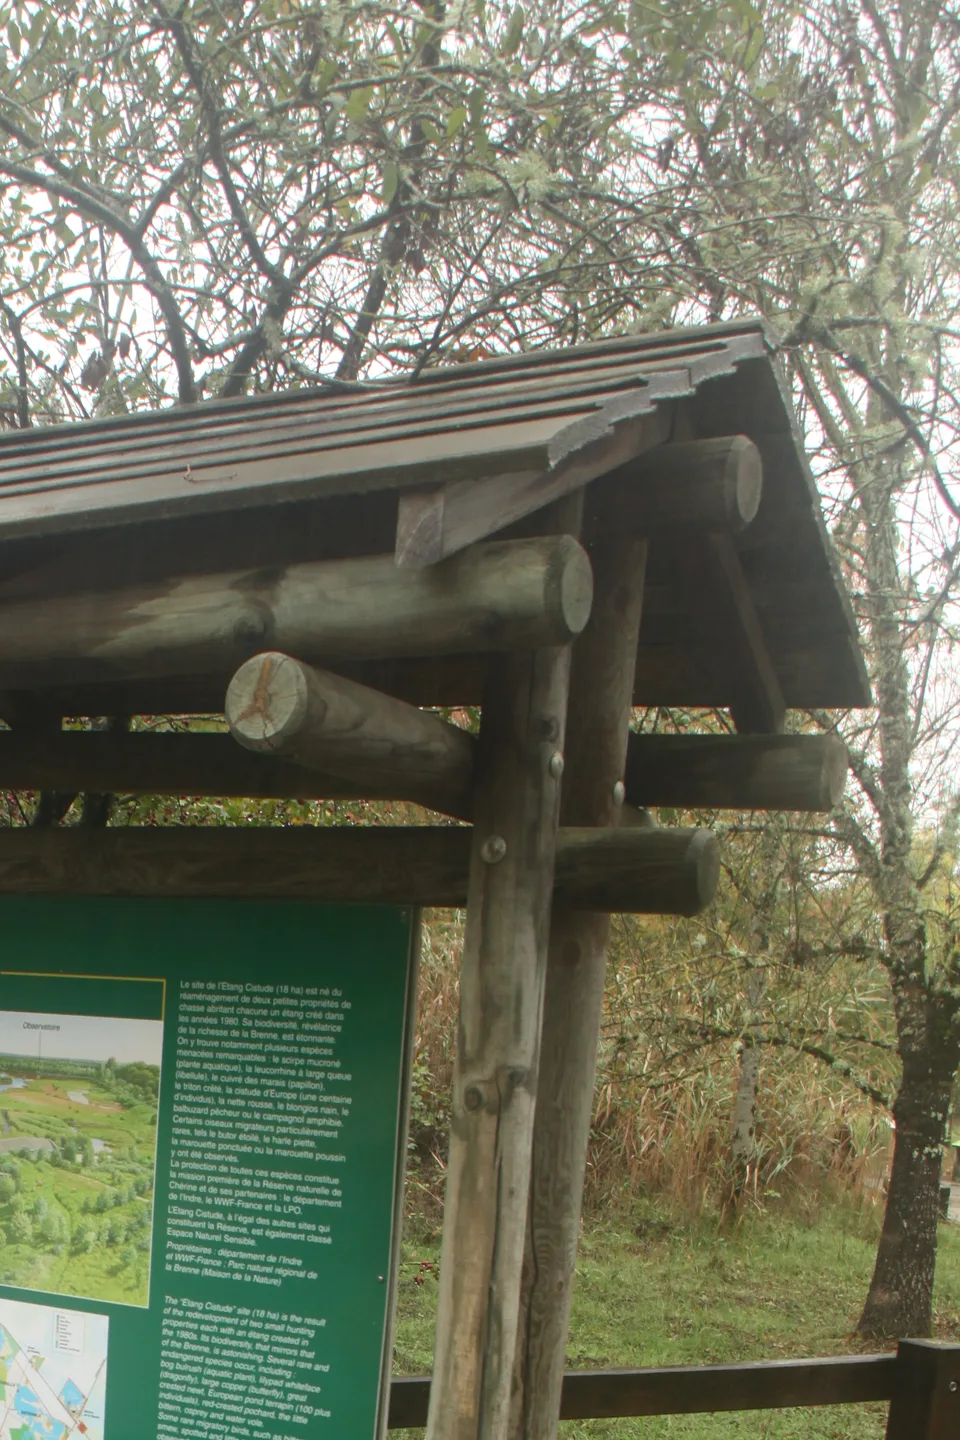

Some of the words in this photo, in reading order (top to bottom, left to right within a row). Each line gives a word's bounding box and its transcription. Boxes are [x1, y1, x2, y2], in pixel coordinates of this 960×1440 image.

[180, 980, 189, 989] Le
[191, 981, 204, 989] site
[206, 981, 216, 990] de
[217, 982, 243, 993] l'Etang
[244, 983, 274, 993] Cistude
[275, 985, 288, 995] (18
[290, 985, 303, 996] ha)
[305, 986, 317, 995] est
[319, 987, 330, 995] né
[331, 987, 342, 996] du
[180, 992, 238, 1004] réaménagement
[240, 995, 250, 1003] de
[252, 995, 270, 1004] deux
[272, 997, 298, 1007] petites
[299, 999, 339, 1009] propriétés
[340, 1000, 352, 1009] de
[179, 1003, 205, 1012] chasse
[206, 1004, 234, 1014] abritant
[235, 1006, 268, 1016] chacune
[281, 1008, 303, 1020] étang
[305, 1010, 323, 1019] créé
[324, 1011, 344, 1020] dans
[23, 1021, 61, 1031] Observatoire
[178, 1014, 189, 1023] les
[190, 1015, 218, 1024] années
[241, 1018, 252, 1027] Sa
[301, 1021, 342, 1032] révélatrice
[178, 1025, 187, 1034] de
[188, 1026, 195, 1035] la
[197, 1027, 228, 1037] richesse
[229, 1029, 239, 1037] de
[241, 1029, 248, 1038] la
[281, 1032, 294, 1041] est
[170, 1159, 179, 1168] La
[180, 1161, 216, 1172] protection
[217, 1163, 228, 1173] de
[229, 1165, 253, 1175] toutes
[254, 1169, 268, 1177] ces
[270, 1170, 302, 1180] espèces
[303, 1174, 340, 1184] constitue
[170, 1170, 176, 1179] la
[177, 1171, 205, 1182] mission
[206, 1176, 239, 1185] première
[241, 1177, 251, 1187] de
[253, 1179, 260, 1188] la
[262, 1180, 294, 1191] Réserve
[295, 1184, 329, 1195] naturelle
[331, 1187, 342, 1196] de
[168, 1191, 178, 1201] de
[205, 1195, 212, 1204] le
[213, 1196, 262, 1210] WWF-France
[264, 1202, 272, 1211] et
[273, 1203, 281, 1212] la
[169, 1180, 197, 1191] Chérine
[198, 1184, 206, 1192] et
[207, 1184, 217, 1194] de
[234, 1189, 277, 1200] partenaires
[283, 1193, 290, 1202] le
[292, 1194, 342, 1207] département
[164, 1295, 178, 1305] The
[236, 1306, 250, 1315] site
[251, 1307, 265, 1318] (18
[266, 1309, 279, 1321] ha)
[280, 1311, 287, 1321] is
[289, 1313, 302, 1323] the
[303, 1317, 326, 1326] result
